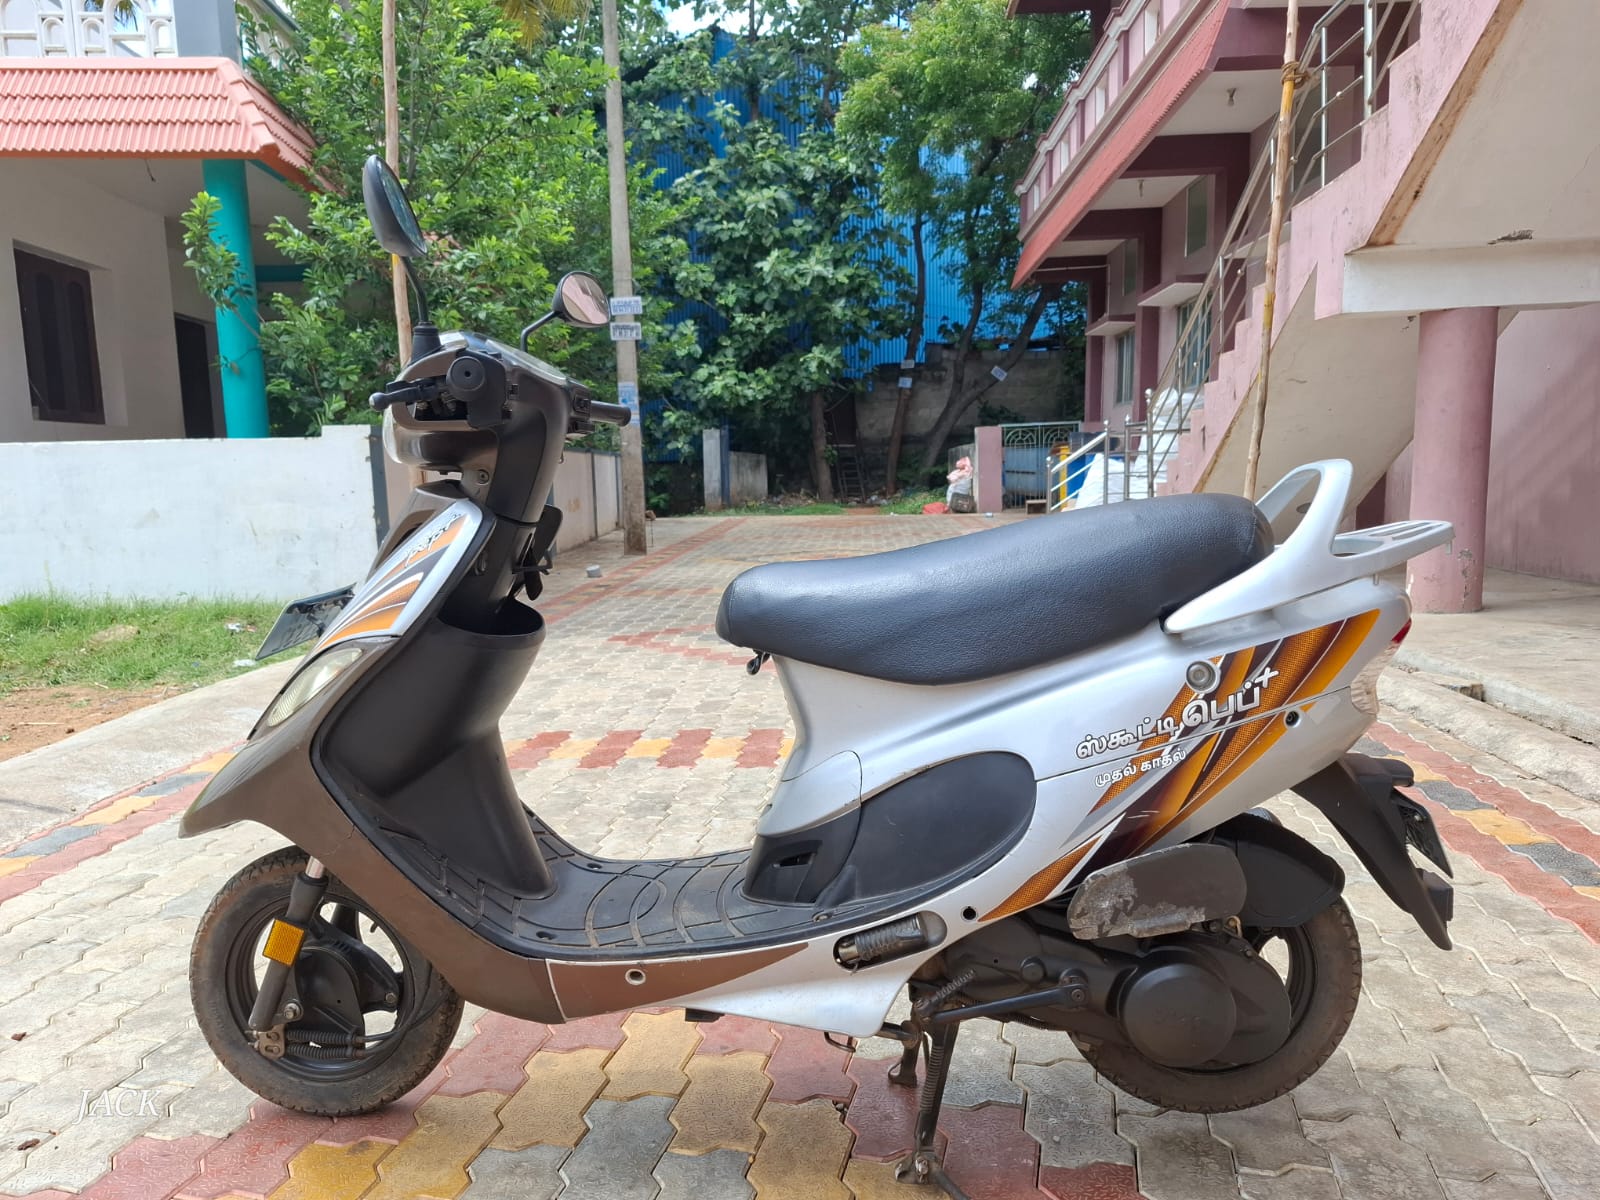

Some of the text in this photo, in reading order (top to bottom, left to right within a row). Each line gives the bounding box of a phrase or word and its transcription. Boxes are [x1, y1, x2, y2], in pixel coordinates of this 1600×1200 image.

[1076, 716, 1181, 759] ஸ்கூட்டி
[1095, 749, 1187, 787] முதல் காதல்
